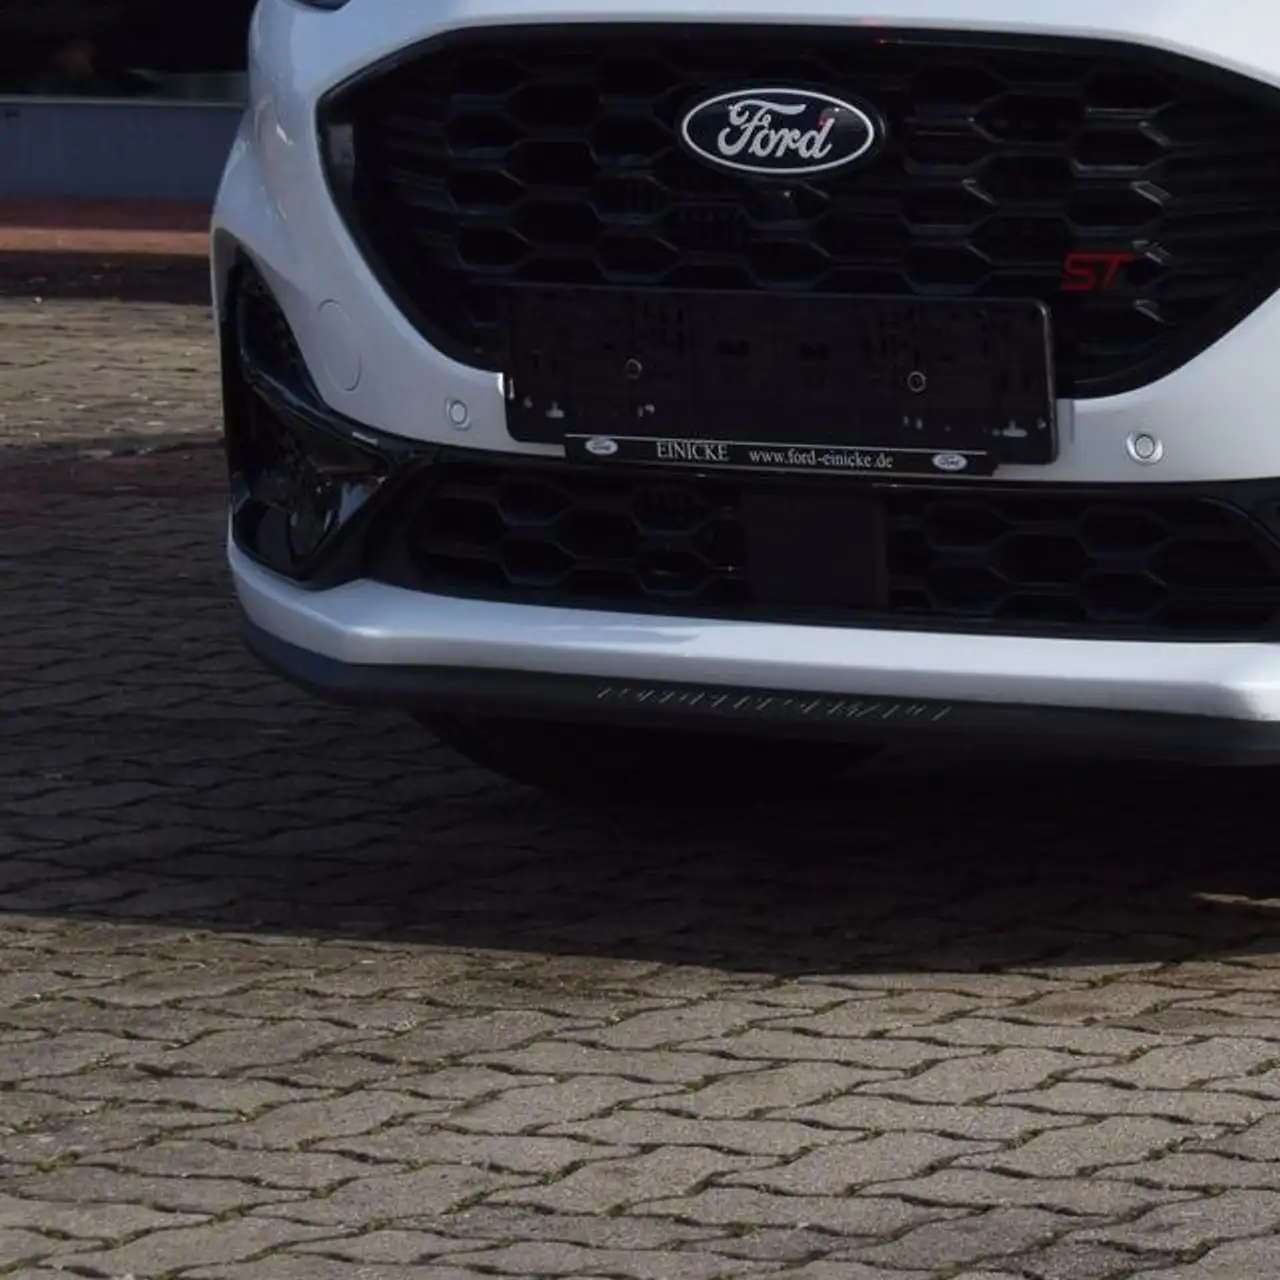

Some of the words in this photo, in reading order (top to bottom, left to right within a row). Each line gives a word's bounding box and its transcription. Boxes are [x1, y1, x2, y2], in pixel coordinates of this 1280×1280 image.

[717, 99, 836, 159] Ford
[1058, 250, 1139, 291] ST
[656, 439, 730, 462] EINICKE
[749, 448, 894, 468] www.ford-einicke.de
